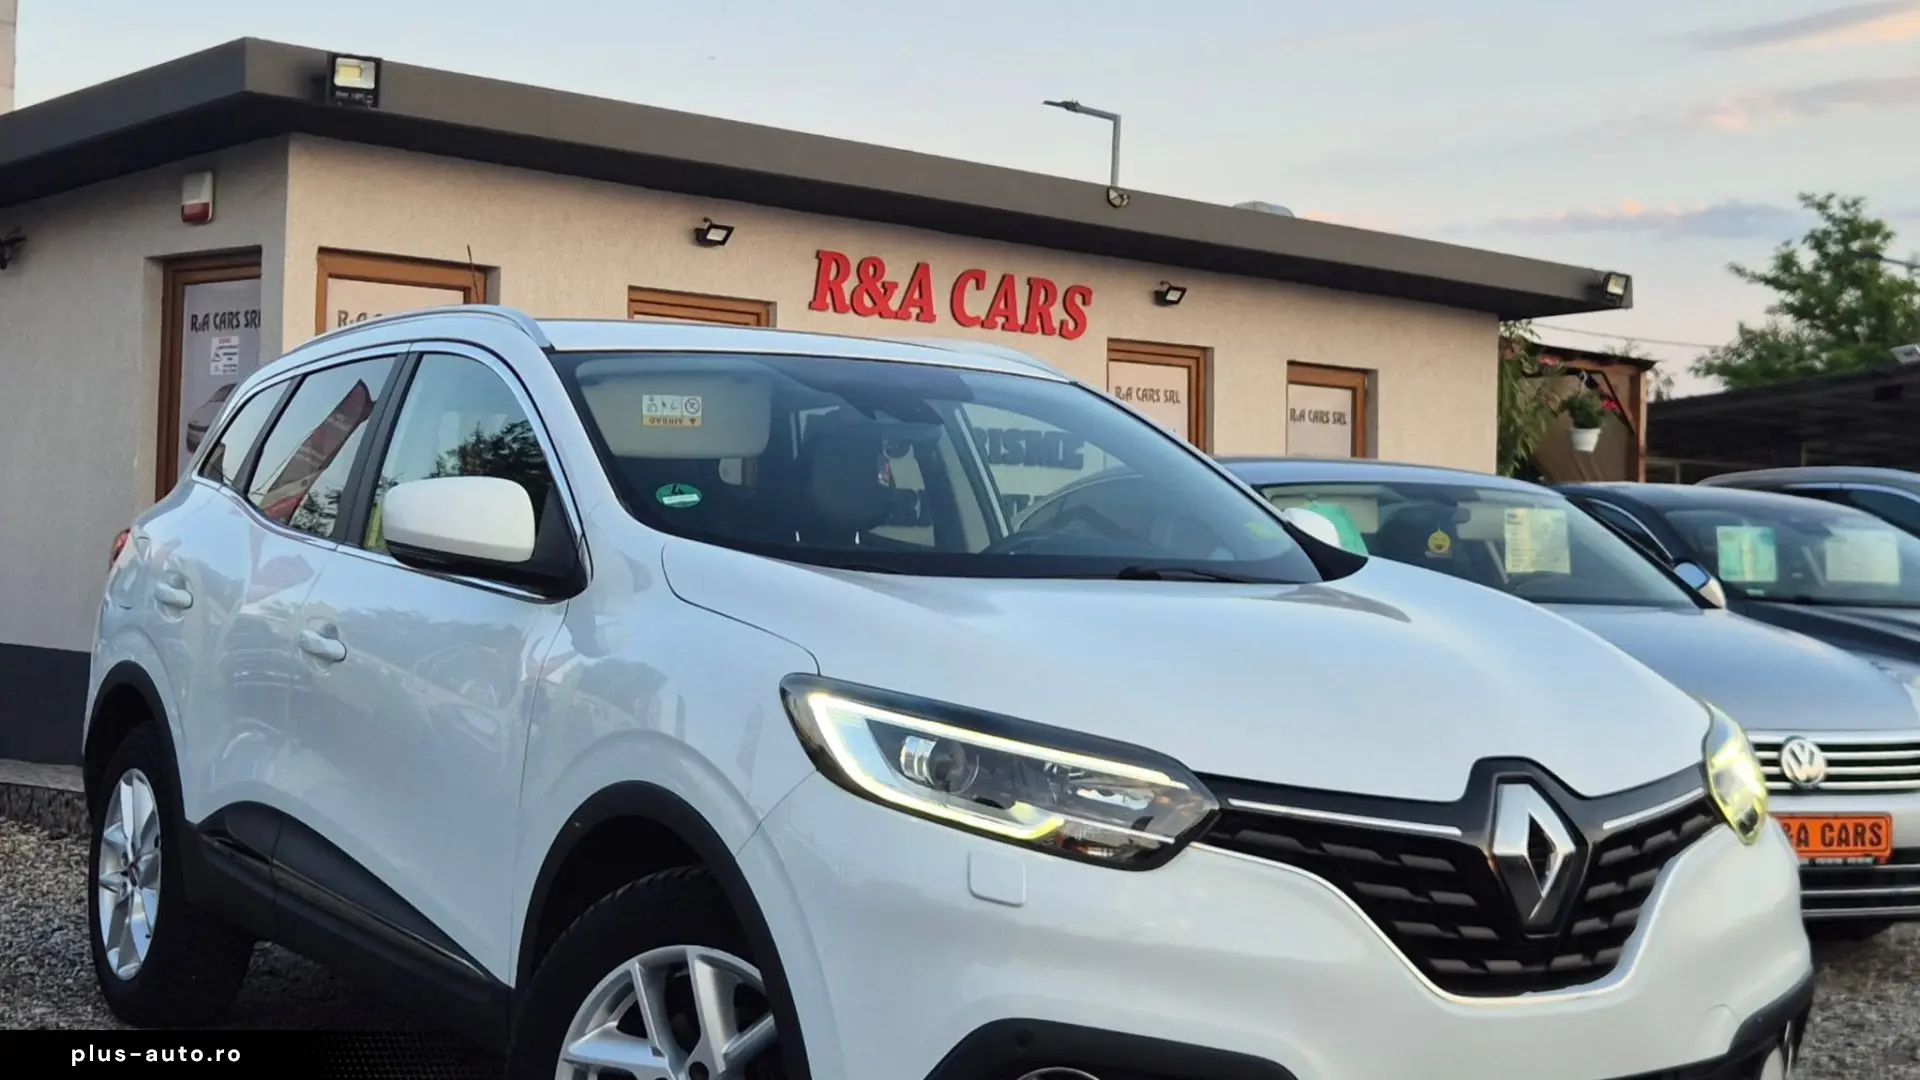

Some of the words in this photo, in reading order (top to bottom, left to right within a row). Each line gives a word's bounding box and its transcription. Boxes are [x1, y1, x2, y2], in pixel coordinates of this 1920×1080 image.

[809, 249, 937, 323] R&A
[950, 268, 1094, 340] CARS
[213, 311, 240, 331] CARS
[1135, 387, 1161, 403] CARS
[1163, 390, 1181, 404] SRL
[1307, 409, 1330, 424] CARS
[1331, 411, 1348, 425] SRL
[1821, 821, 1883, 848] CARS
